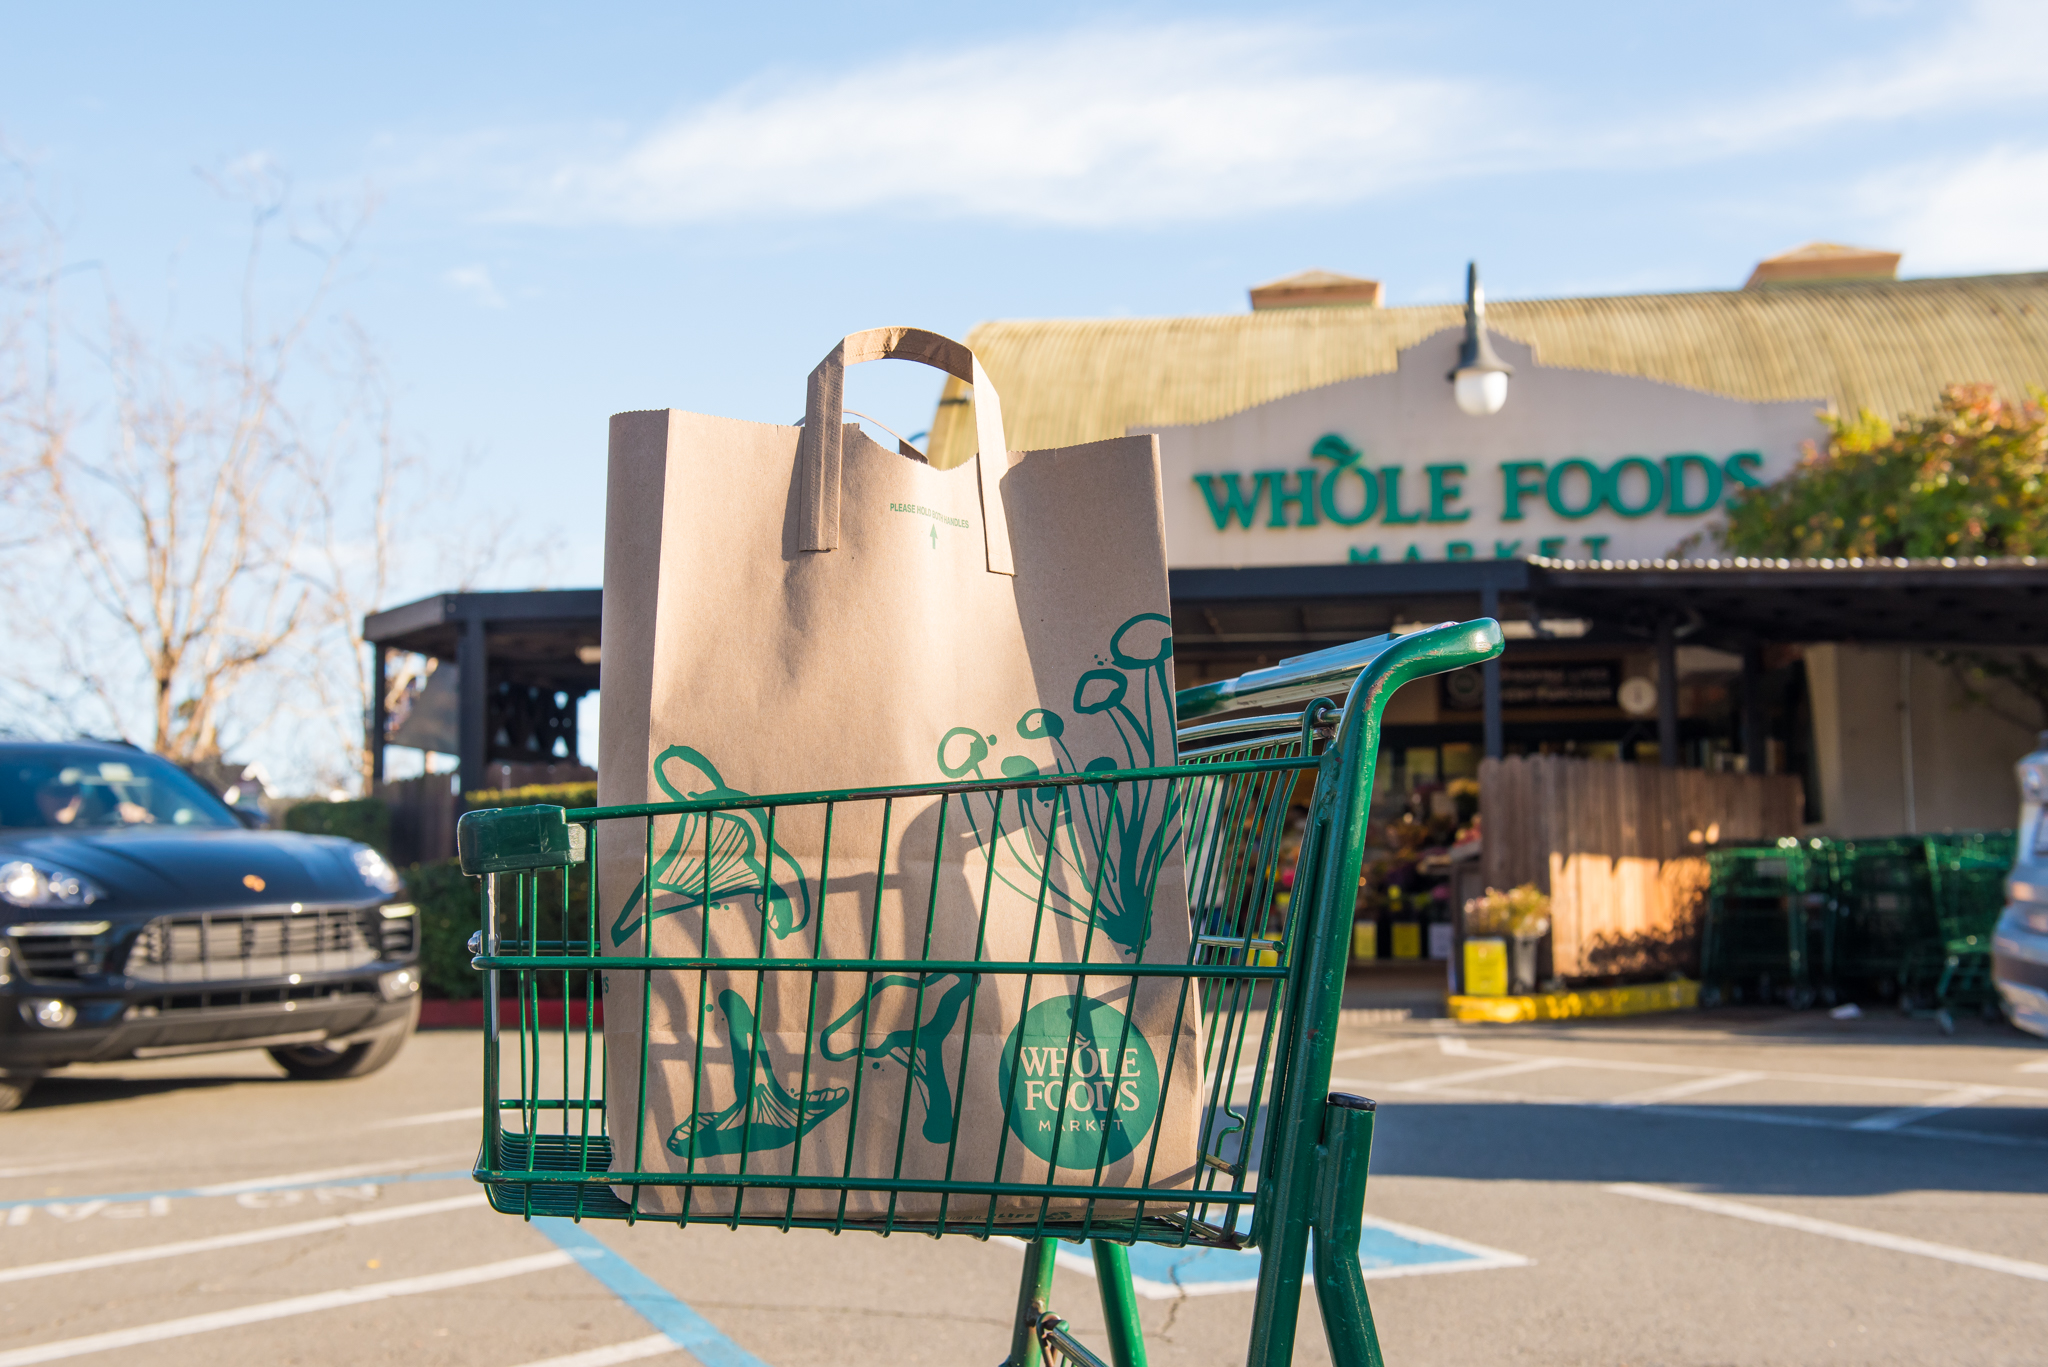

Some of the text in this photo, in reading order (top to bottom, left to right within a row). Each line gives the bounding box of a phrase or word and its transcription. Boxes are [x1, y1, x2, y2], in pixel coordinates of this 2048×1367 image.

[1193, 451, 1765, 530] WHOLE FOODS
[890, 503, 969, 528] PLEASE HOLD BOTH HANDLES
[1019, 1046, 1141, 1078] WHOLE
[1024, 1080, 1140, 1112] FOODS
